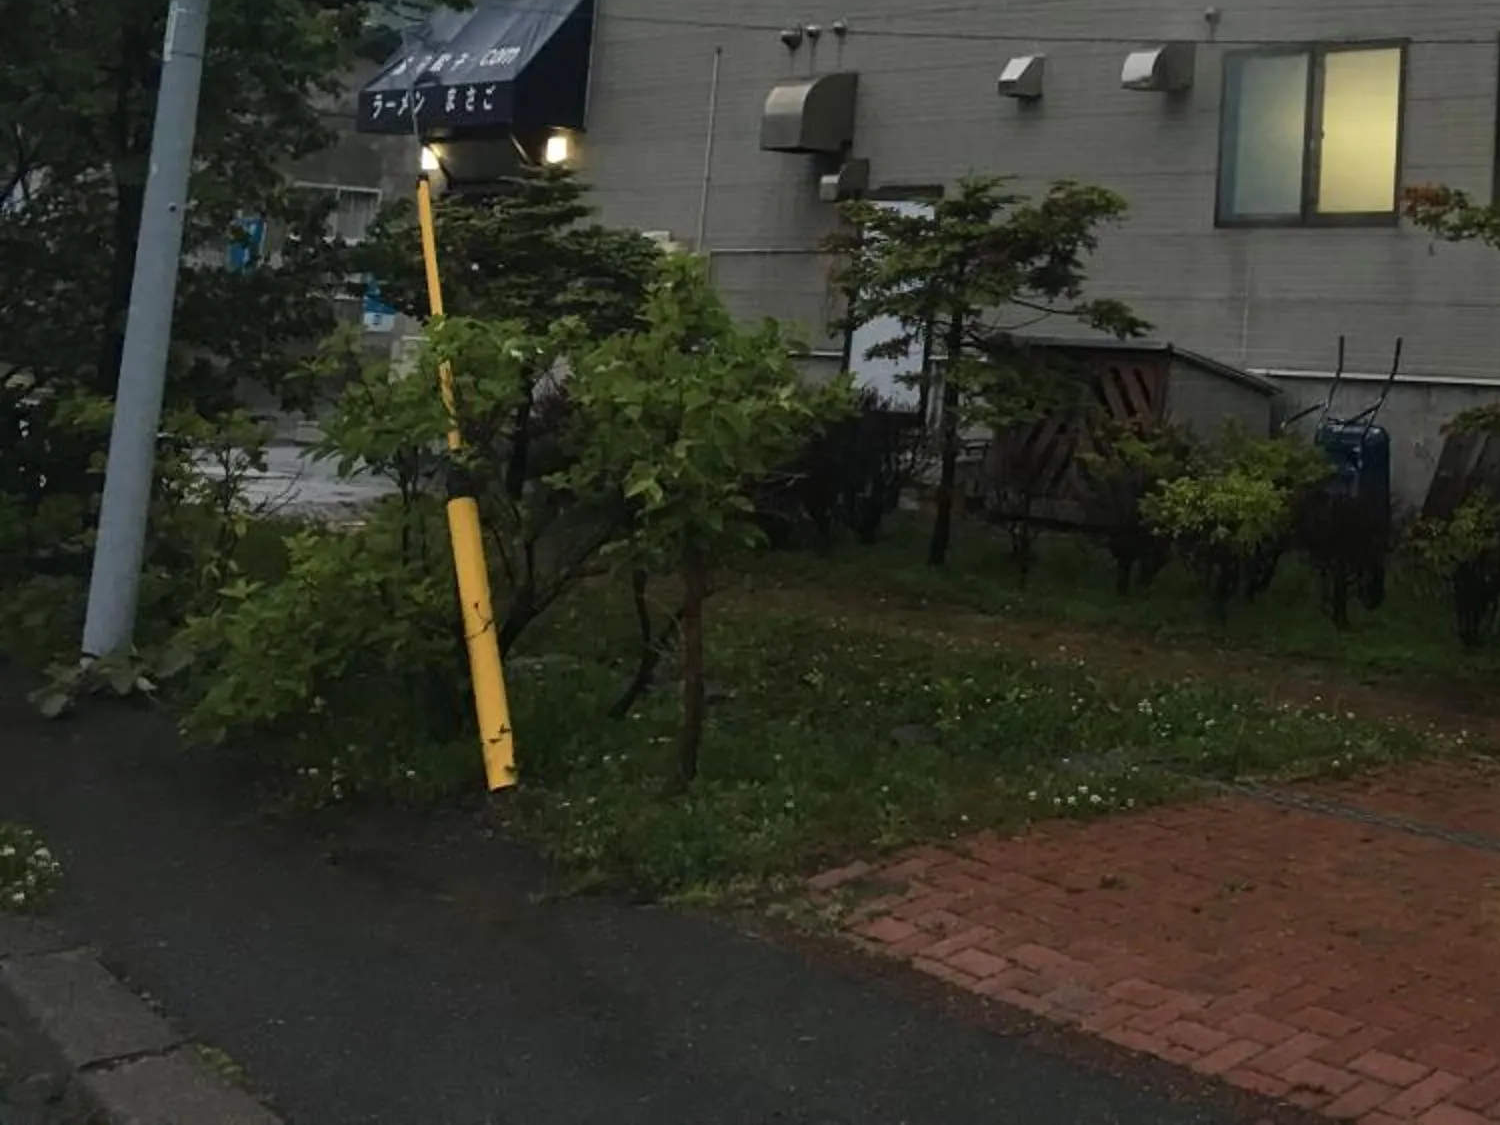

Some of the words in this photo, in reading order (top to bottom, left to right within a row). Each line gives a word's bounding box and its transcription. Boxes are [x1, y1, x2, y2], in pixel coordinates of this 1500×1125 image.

[372, 88, 426, 120] ラーメン
[444, 84, 497, 113] まさご
